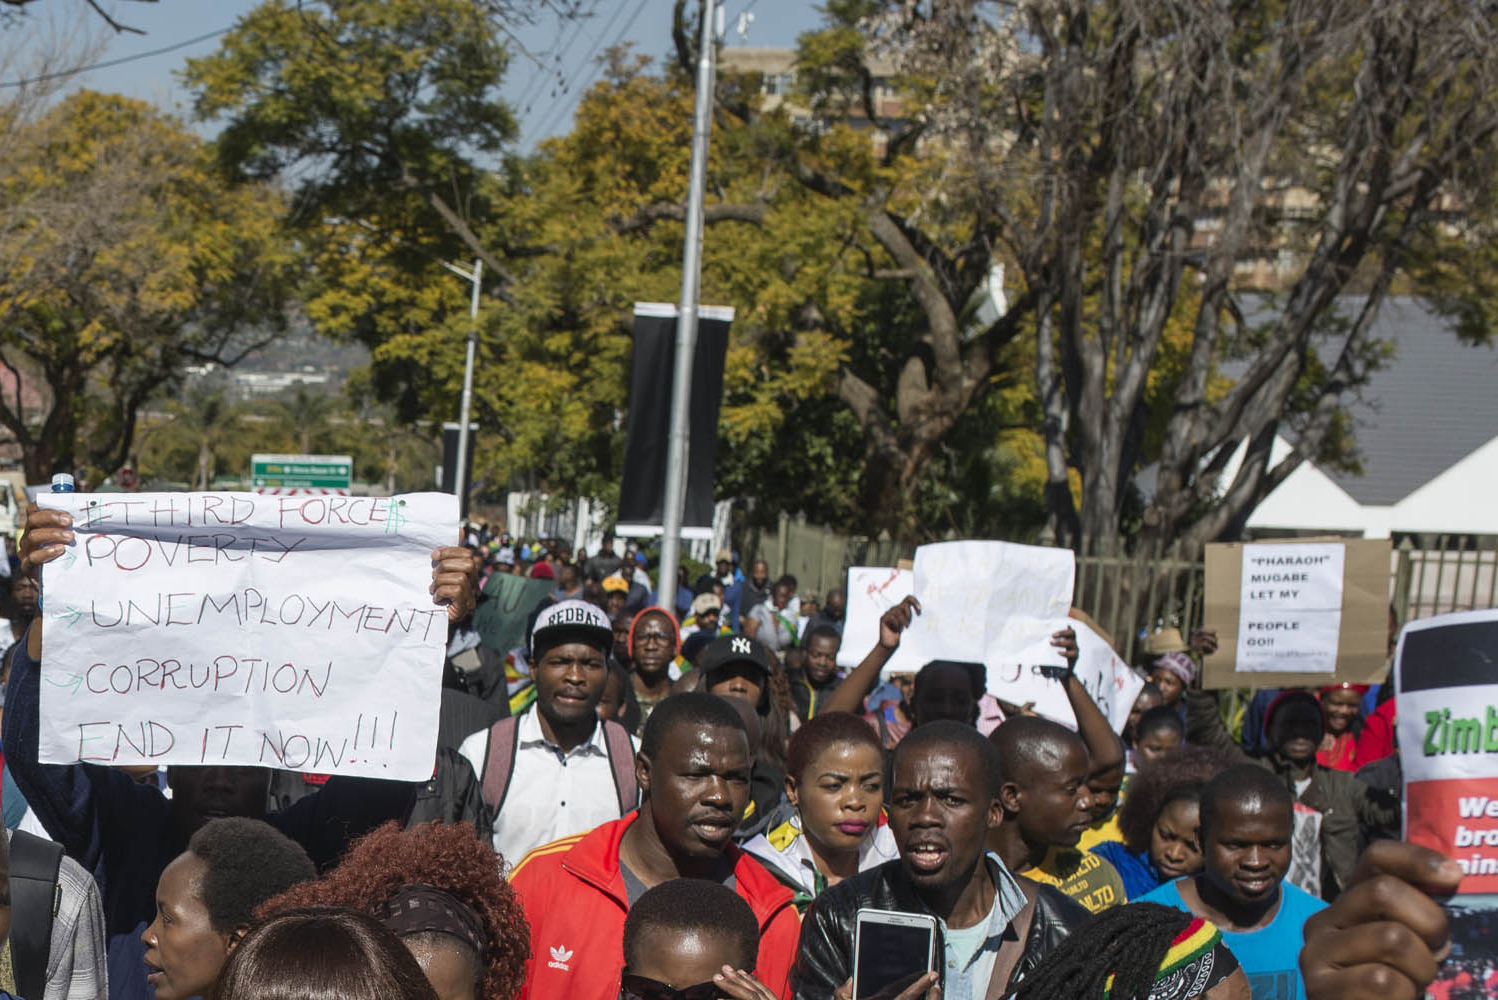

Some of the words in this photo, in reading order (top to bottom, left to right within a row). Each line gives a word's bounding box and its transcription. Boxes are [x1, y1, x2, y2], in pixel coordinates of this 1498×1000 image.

[85, 532, 306, 571] POVERTY
[1250, 572, 1310, 584] MUGABE
[1250, 590, 1275, 600] LET
[1279, 590, 1300, 599] MY
[91, 587, 447, 642] UNEMPLOYMENT
[548, 607, 601, 627] REDBAT
[1248, 621, 1301, 632] PEOPLE
[1246, 637, 1275, 648] GO!!
[86, 654, 332, 698] CORRUPTION
[78, 720, 175, 763] END
[201, 724, 244, 763] IT
[259, 710, 398, 769] NOW!!!
